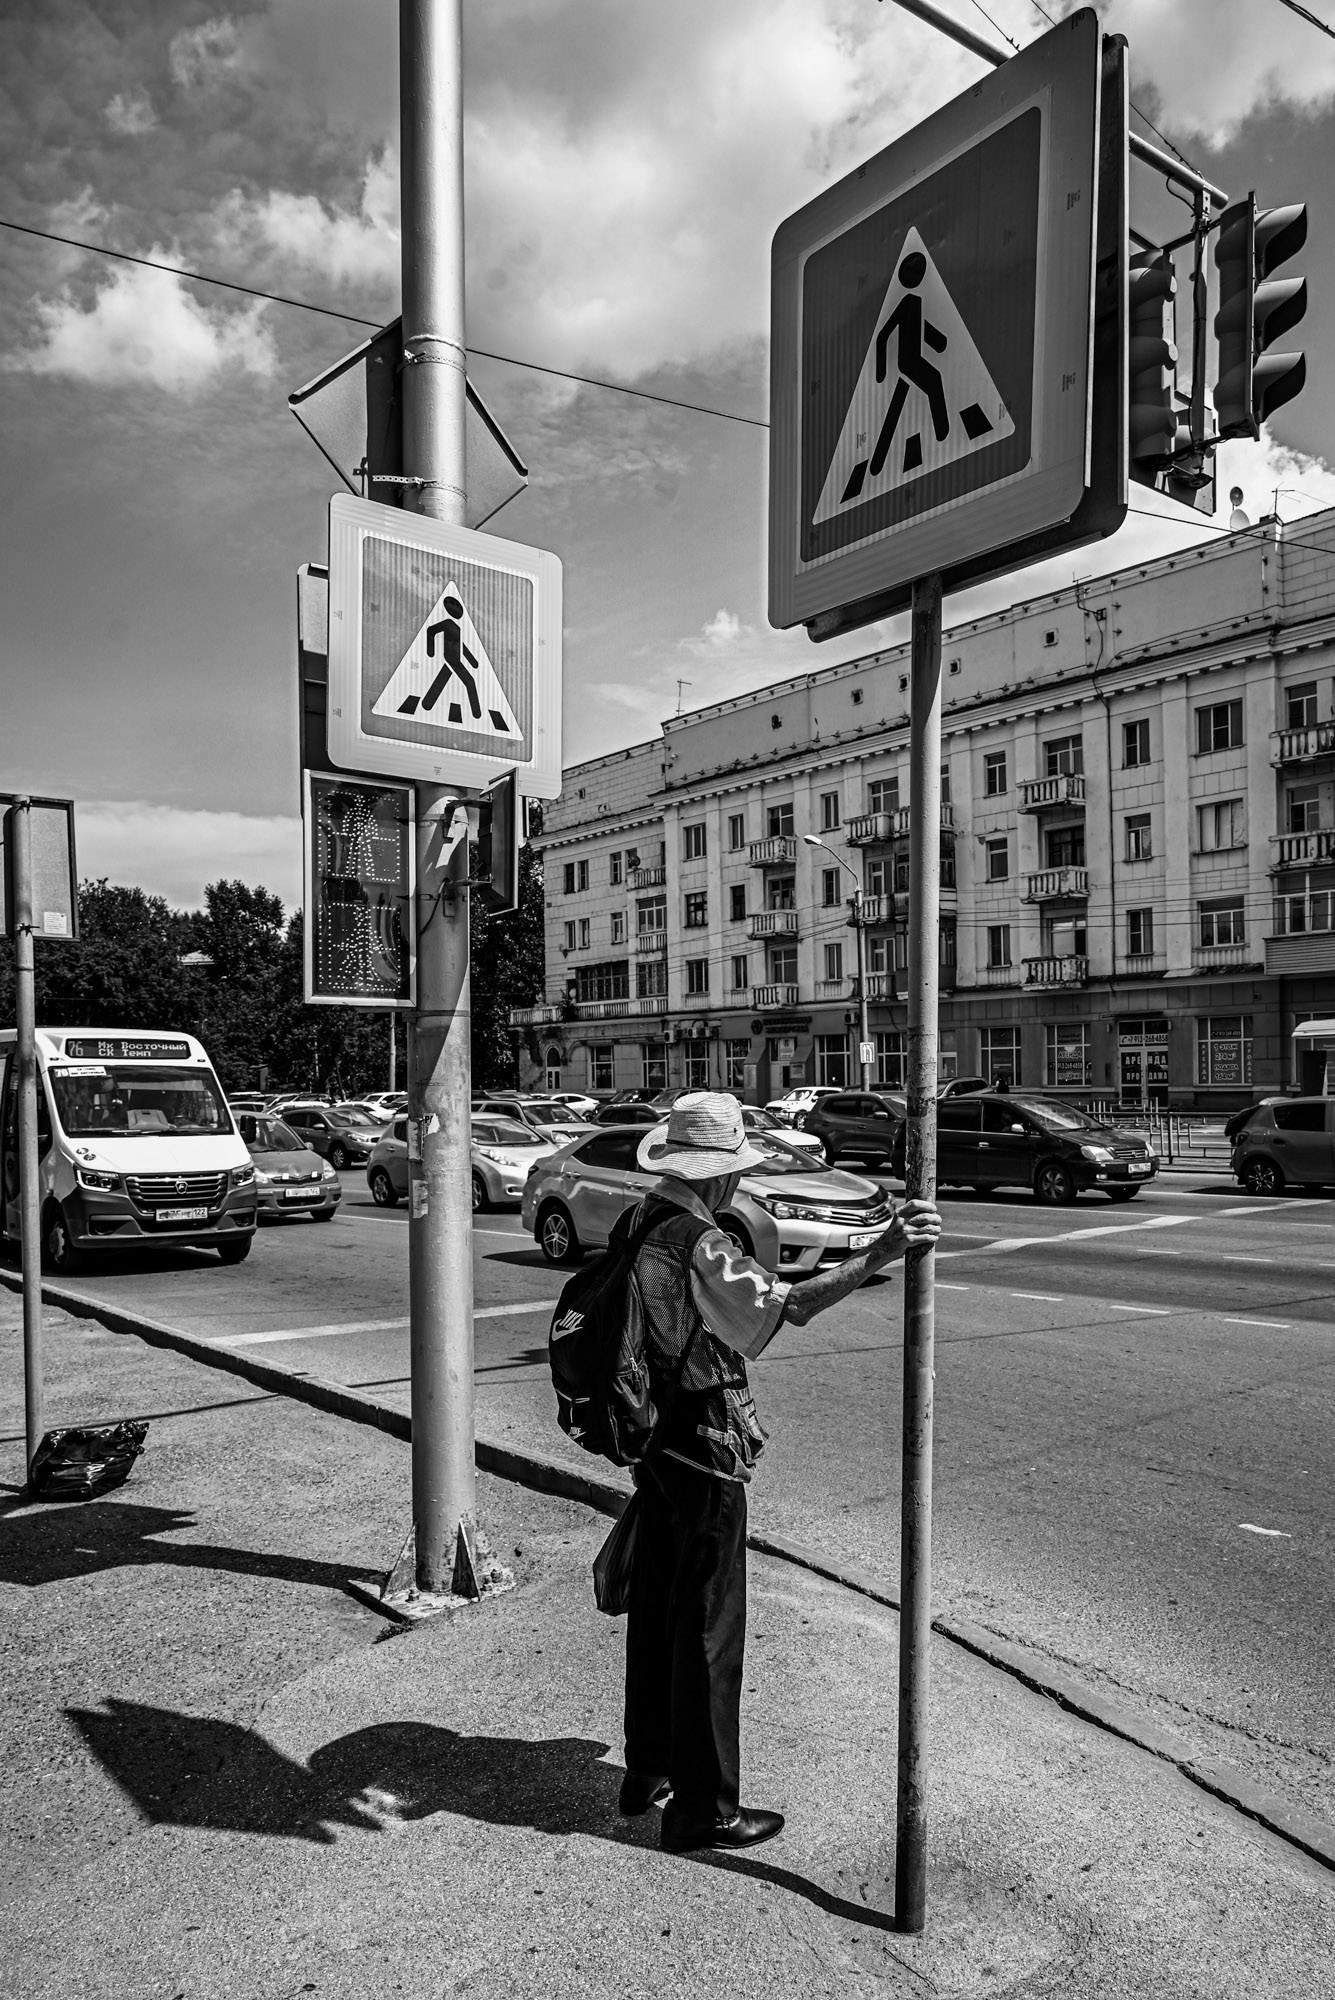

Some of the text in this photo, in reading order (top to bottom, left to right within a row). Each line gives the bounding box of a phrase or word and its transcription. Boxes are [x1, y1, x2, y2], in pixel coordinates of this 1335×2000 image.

[68, 1041, 84, 1057] 76
[121, 1041, 187, 1051] Восточный
[122, 1049, 152, 1057] Темп
[1125, 1055, 1167, 1066] АРЕНДА
[1126, 1072, 1168, 1081] ПРОДАЖА
